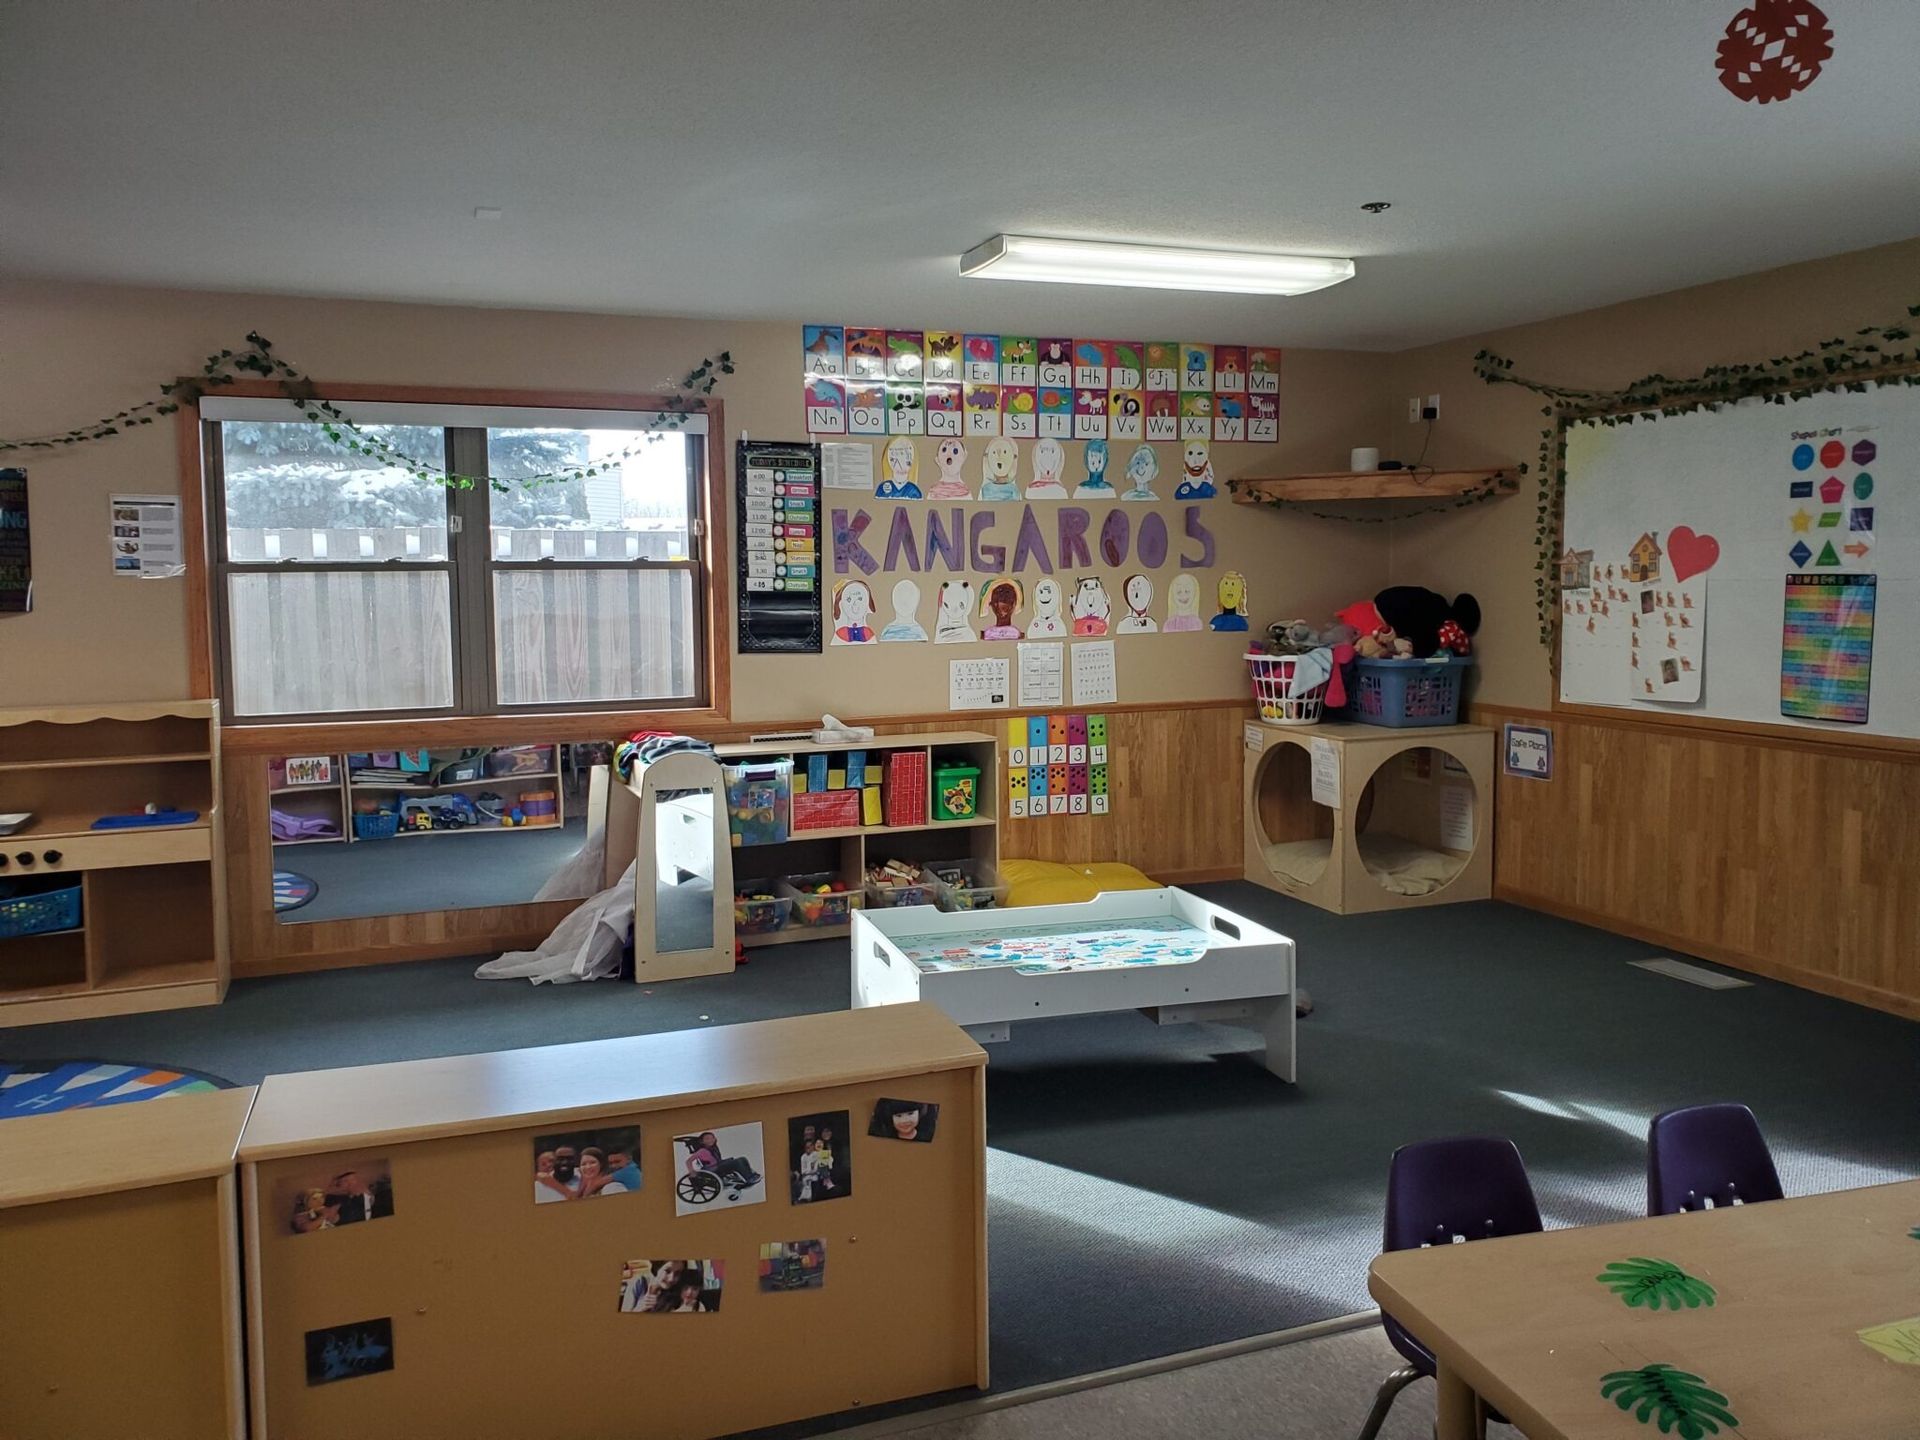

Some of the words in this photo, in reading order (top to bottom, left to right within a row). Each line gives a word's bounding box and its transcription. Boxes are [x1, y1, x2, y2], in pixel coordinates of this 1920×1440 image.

[813, 358, 836, 373] Aa
[894, 361, 915, 377] Cc
[932, 363, 954, 378] Dd
[973, 364, 990, 380] Ee
[1011, 366, 1027, 381] Ff
[1081, 368, 1101, 384] Hh
[1121, 370, 1131, 384] Ii
[1155, 371, 1168, 390] Jj
[1188, 372, 1204, 387] Kk
[1224, 373, 1236, 388] Ll
[1251, 375, 1276, 390] Mm
[813, 409, 837, 426] Nn
[854, 410, 879, 426] Oo
[896, 411, 916, 433] Pp
[931, 413, 958, 435] Qq
[974, 414, 990, 429] Rr
[1011, 415, 1026, 430] Ss
[1047, 416, 1061, 431] Tt
[1081, 418, 1099, 432] Uu
[1117, 418, 1135, 433] Vv
[1148, 419, 1174, 433] Ww
[1187, 420, 1204, 434] Xx
[1221, 421, 1237, 440] Yy
[1254, 421, 1271, 435] Zz
[831, 505, 1214, 574] KANGAROOS
[1787, 575, 1845, 585] NUMBERS
[1512, 738, 1527, 748] Safe
[1528, 741, 1546, 750] Place
[1013, 749, 1024, 764] 0
[1054, 747, 1063, 761] 2
[1073, 747, 1082, 761] 3
[1095, 747, 1103, 761] 4
[1014, 800, 1023, 815] 5
[1034, 798, 1043, 812] 6
[1055, 797, 1064, 811] 7
[1074, 797, 1082, 811] 8
[1095, 797, 1104, 811] 9
